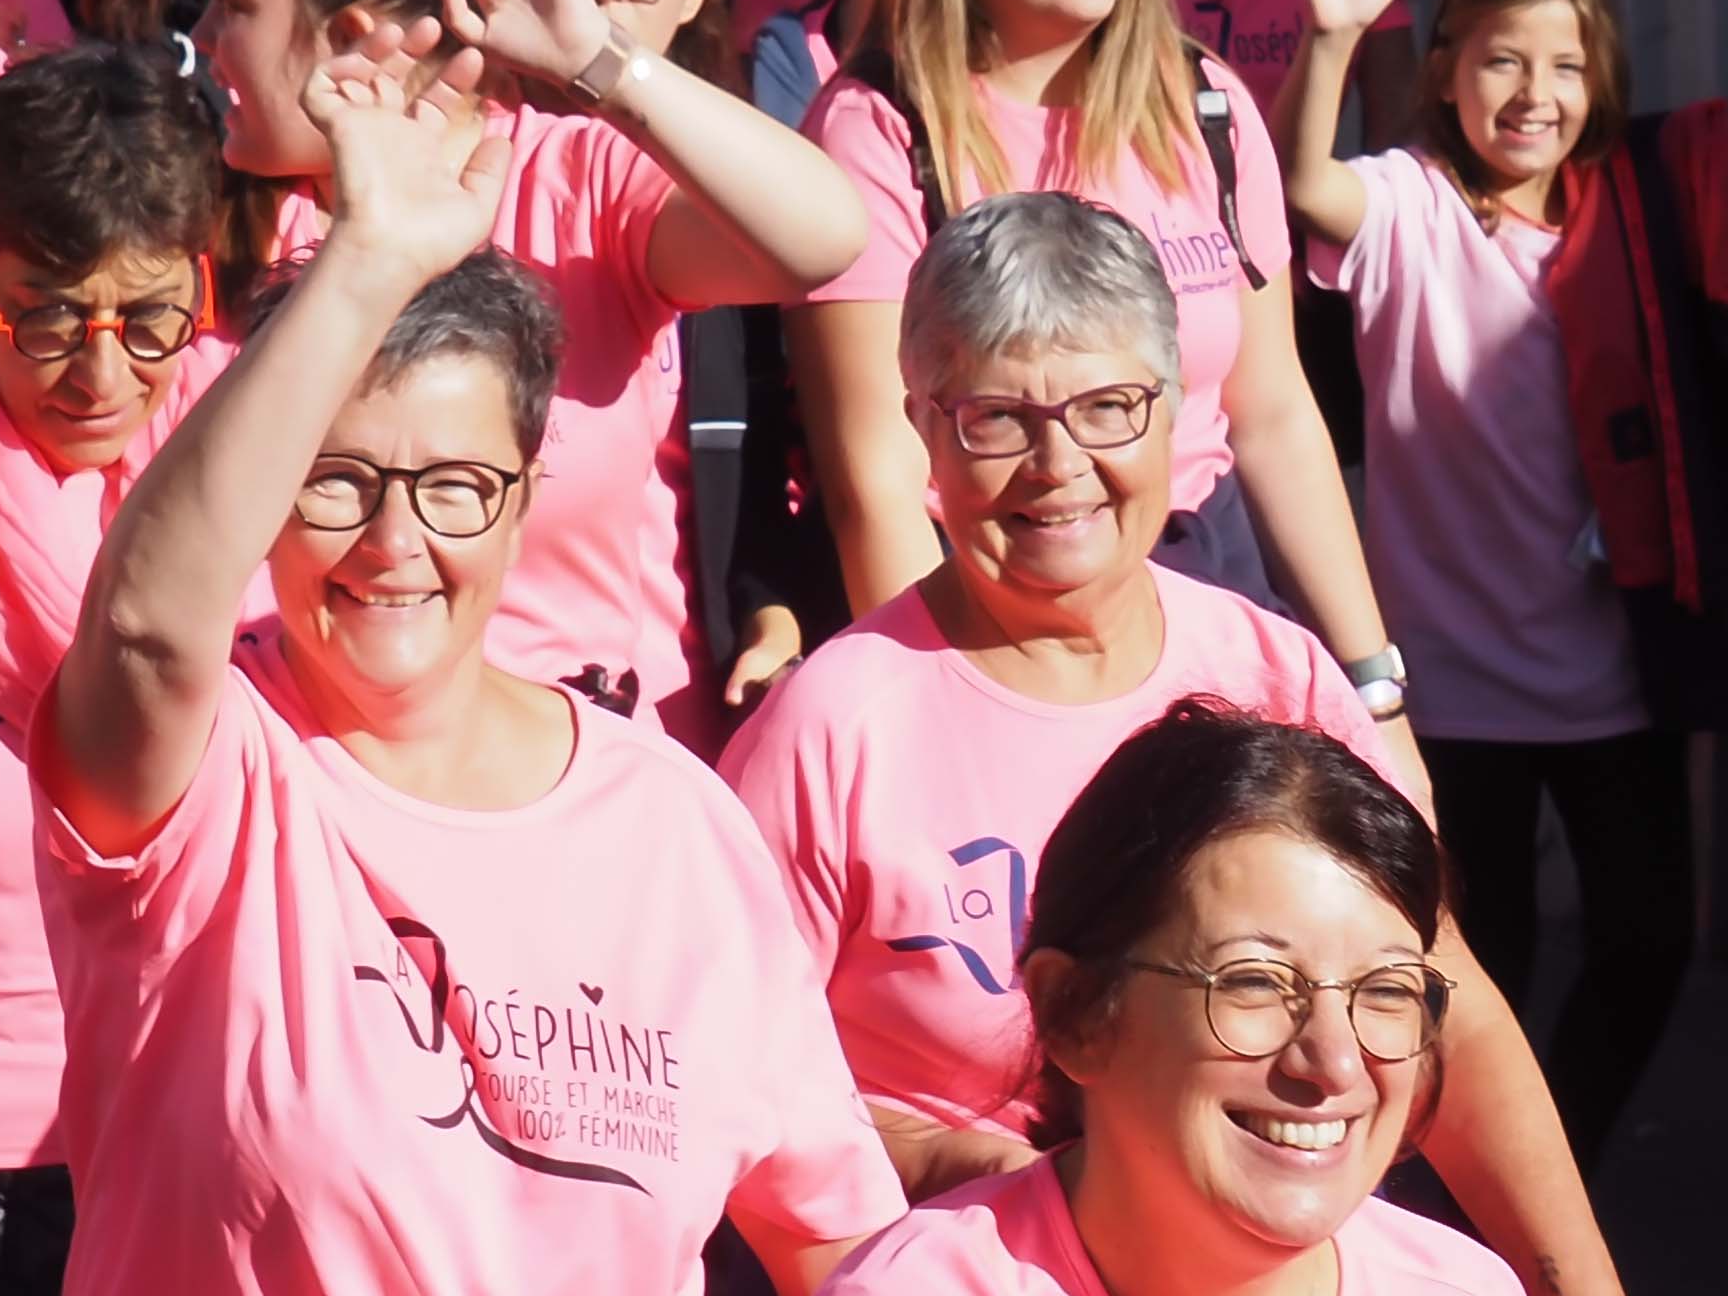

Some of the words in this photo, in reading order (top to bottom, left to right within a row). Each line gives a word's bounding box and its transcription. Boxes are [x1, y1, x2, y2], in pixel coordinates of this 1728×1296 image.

[943, 882, 994, 924] la
[480, 1071, 552, 1107] OURSE
[567, 1081, 588, 1109] ET
[604, 1085, 679, 1129] MARCHE
[516, 1108, 567, 1142] 100%
[578, 1110, 679, 1163] FÉMININE
